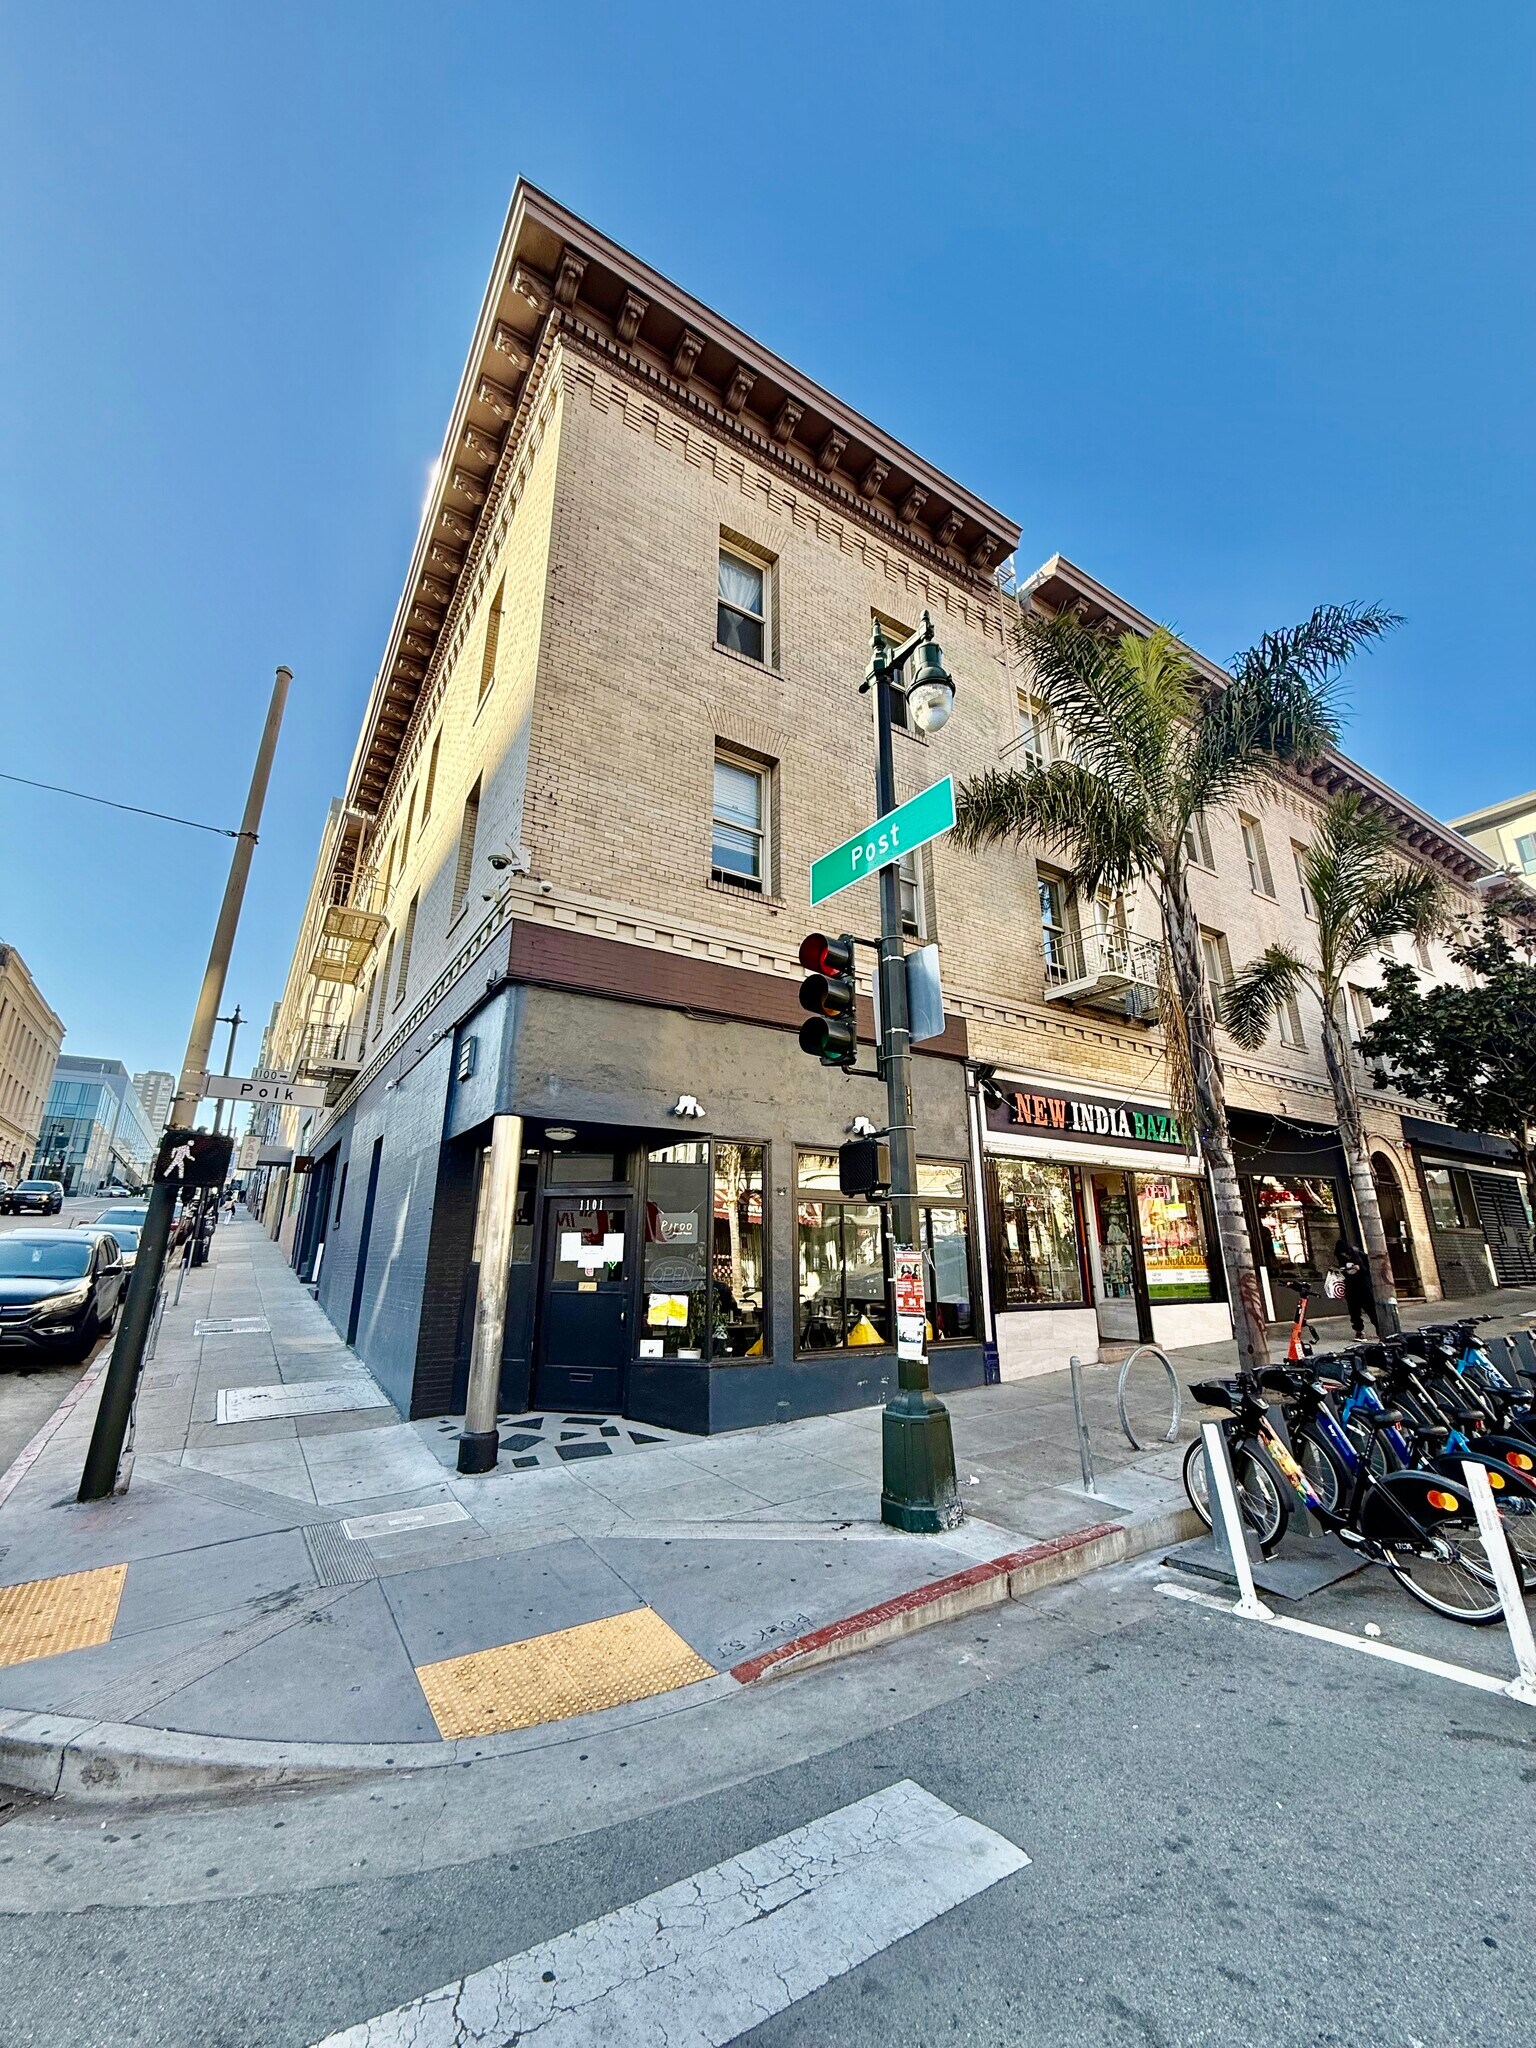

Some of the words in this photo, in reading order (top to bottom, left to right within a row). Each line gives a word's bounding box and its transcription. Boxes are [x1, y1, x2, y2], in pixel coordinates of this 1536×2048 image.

[851, 823, 900, 871] Post
[253, 1069, 277, 1080] 1100
[240, 1083, 294, 1101] Polk
[1015, 1092, 1066, 1129] NEW
[1070, 1101, 1132, 1138] INDIA
[1132, 1111, 1191, 1146] BAZA
[243, 1137, 257, 1168] PARK
[1146, 1185, 1169, 1199] OPEN
[580, 1199, 604, 1211] 1101
[651, 1267, 695, 1284] OPEN
